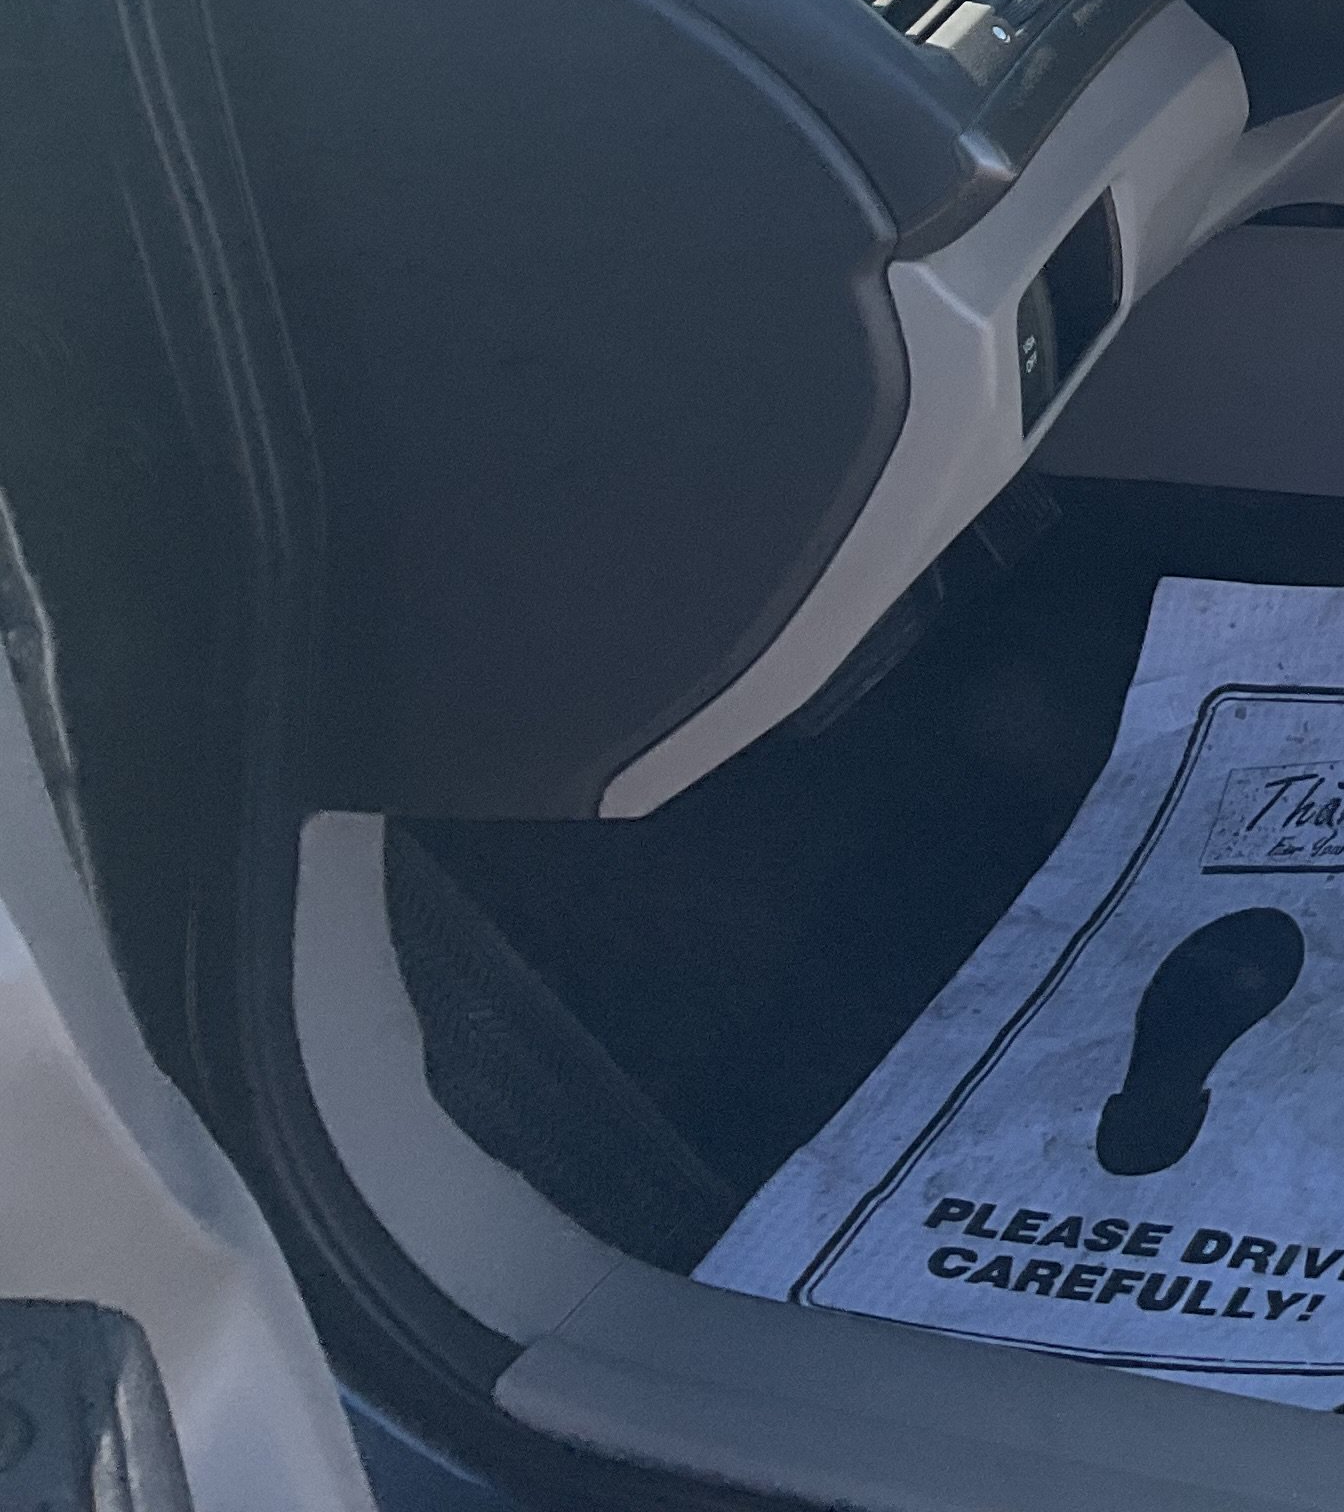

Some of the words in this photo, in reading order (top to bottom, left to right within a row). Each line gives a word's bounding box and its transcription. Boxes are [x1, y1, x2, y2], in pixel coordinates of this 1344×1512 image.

[1267, 836, 1304, 857] For
[923, 1197, 1174, 1258] PLEASE
[927, 1246, 1327, 1322] CAREFULLY!
